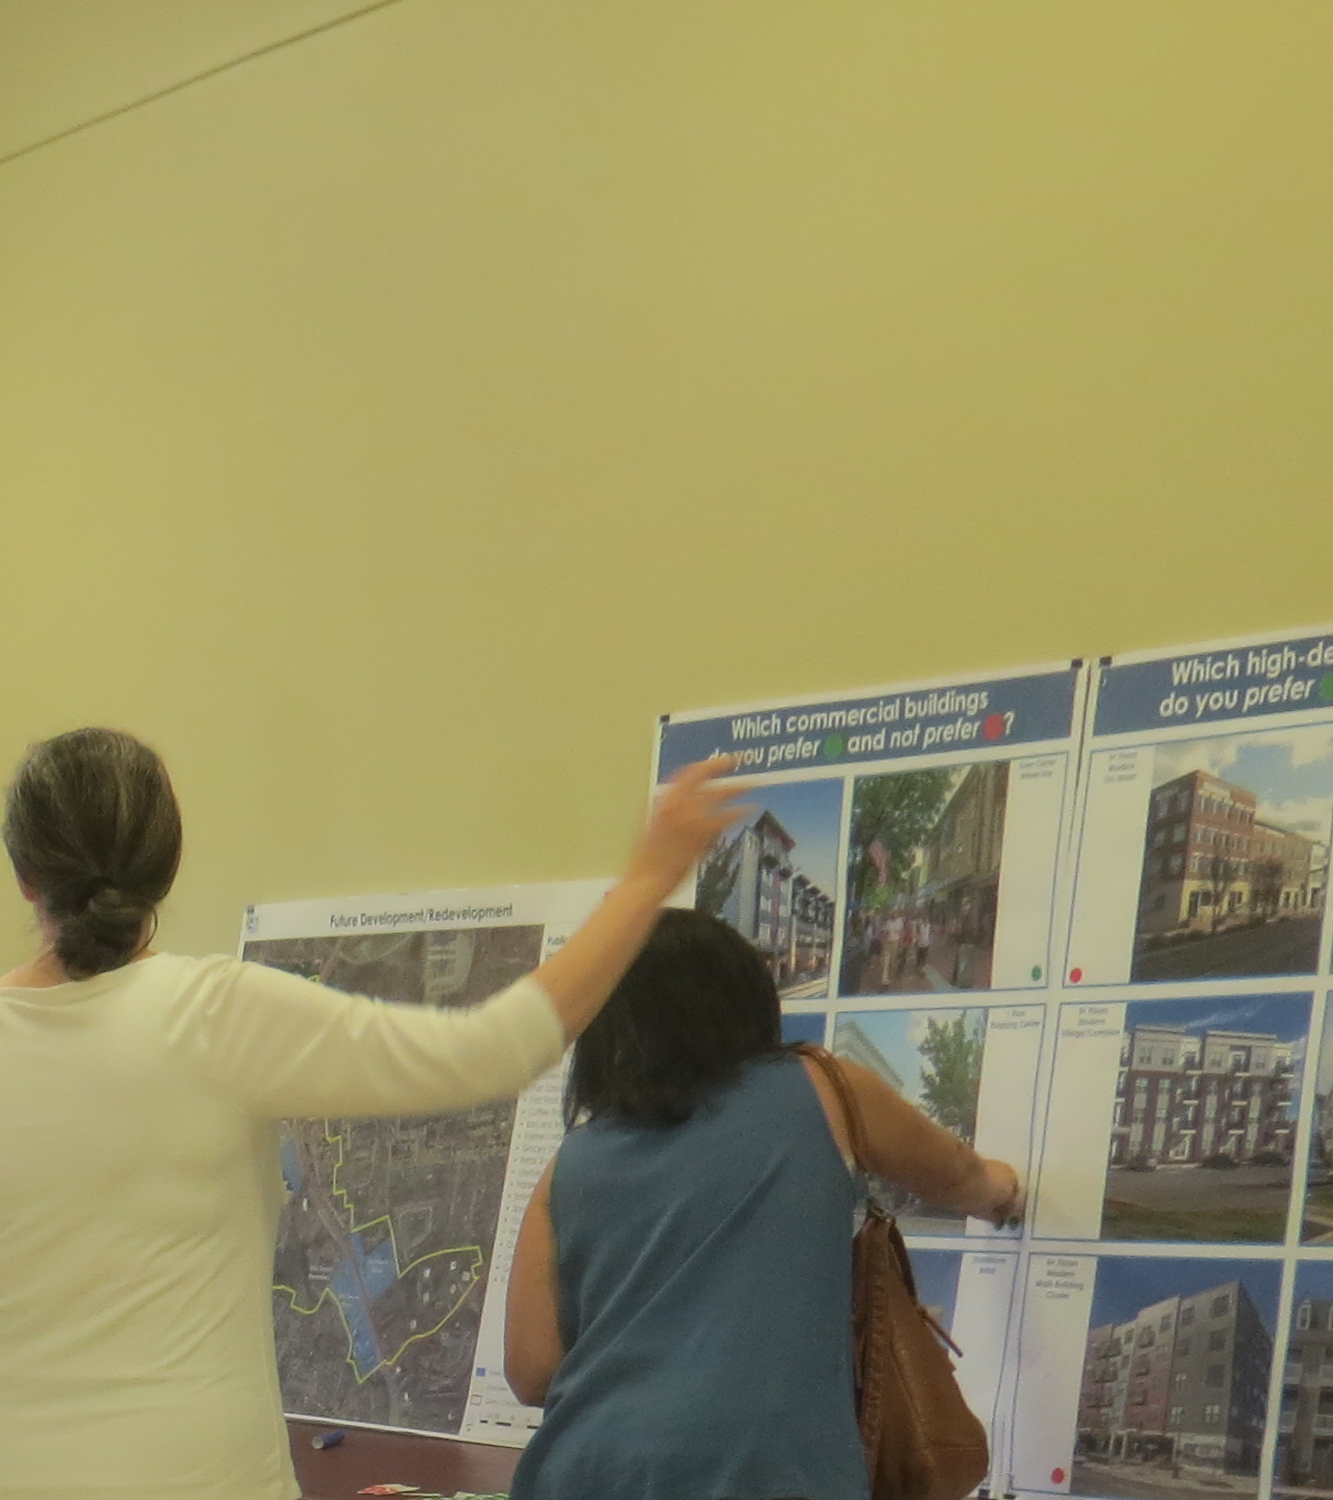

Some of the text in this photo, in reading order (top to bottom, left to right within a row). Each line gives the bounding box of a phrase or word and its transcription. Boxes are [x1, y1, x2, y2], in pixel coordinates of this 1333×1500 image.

[1172, 657, 1239, 686] Which
[732, 688, 989, 740] Which commercial buildings
[1159, 676, 1316, 719] do you prefer
[767, 737, 821, 767] prefer
[847, 727, 885, 754] and
[890, 724, 919, 749] not
[923, 717, 981, 750] prefer
[1003, 711, 1015, 736] ?
[330, 903, 513, 928] Future Development/Redevelopment
